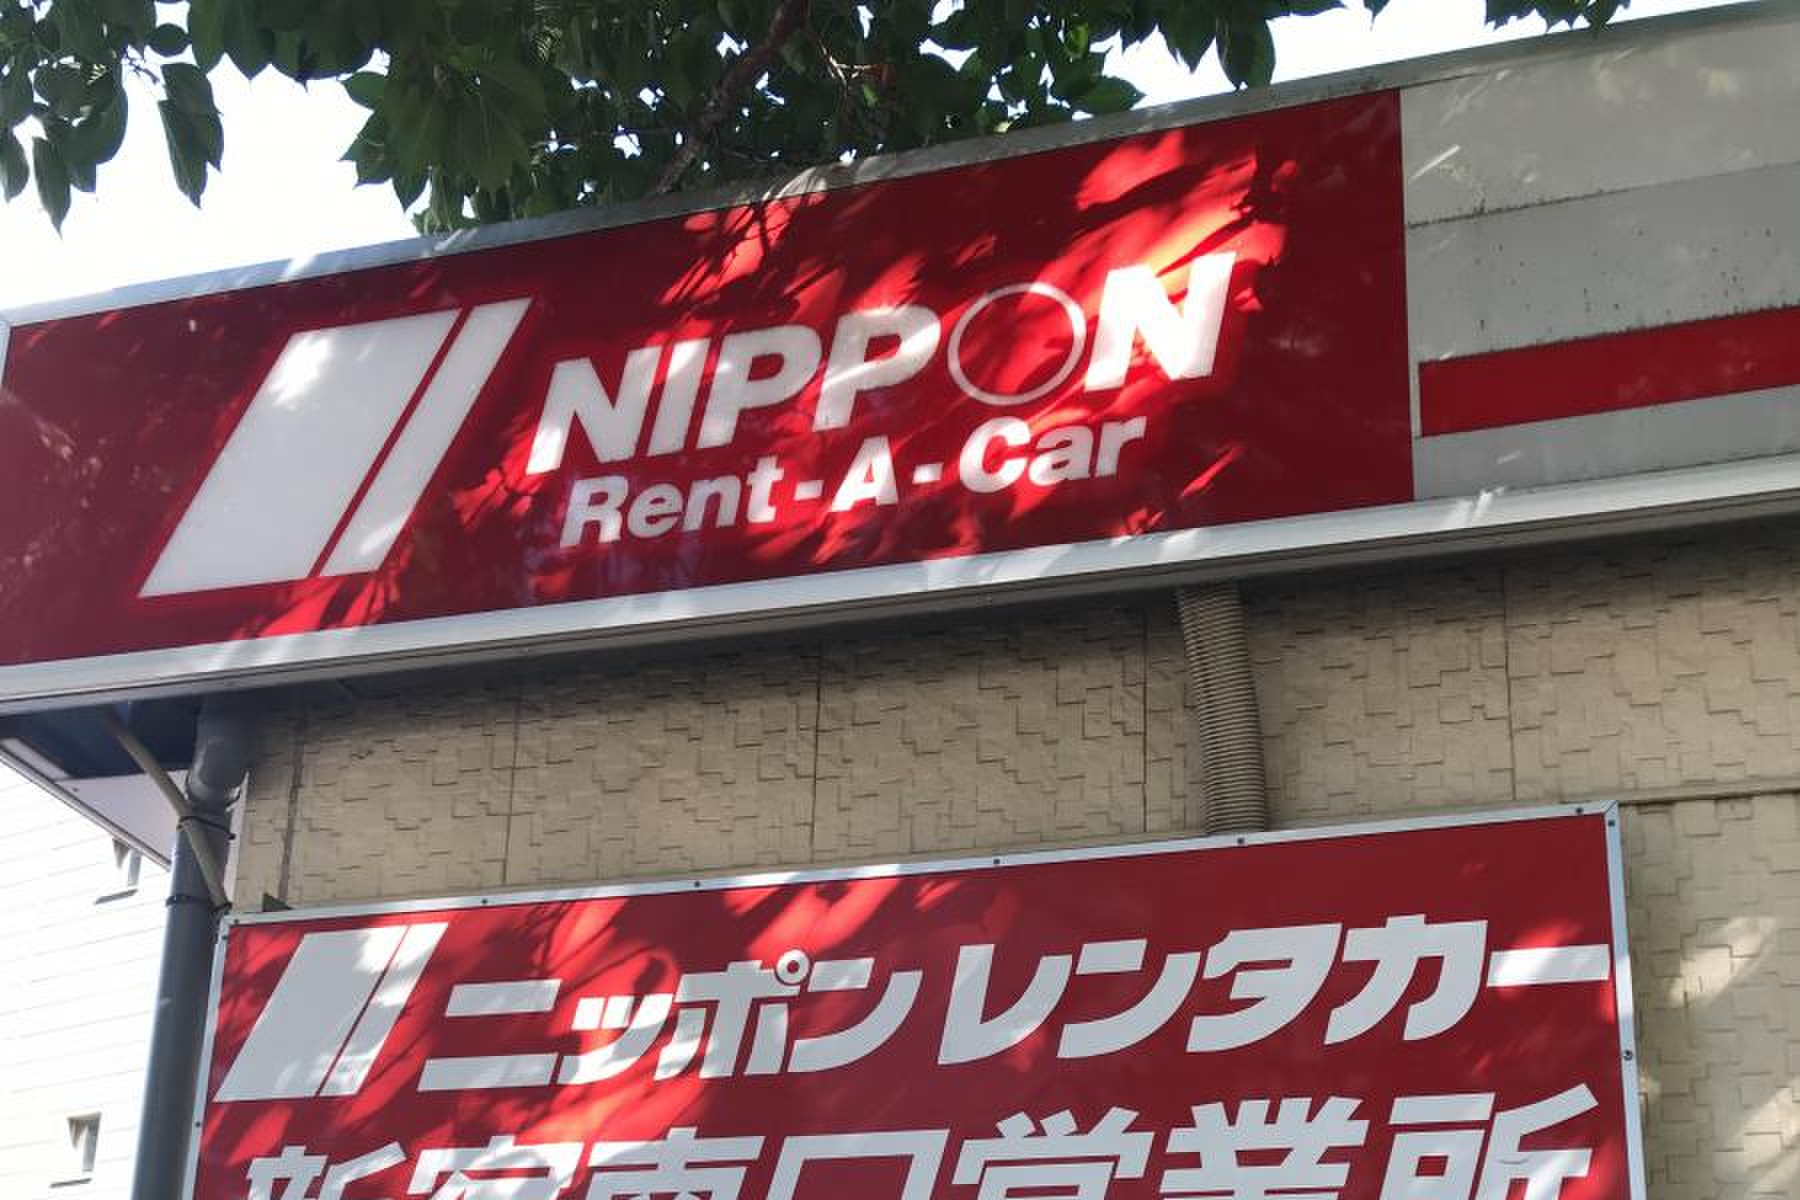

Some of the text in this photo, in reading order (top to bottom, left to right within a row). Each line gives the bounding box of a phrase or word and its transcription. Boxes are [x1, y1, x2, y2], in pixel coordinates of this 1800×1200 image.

[527, 251, 1235, 474] NIPPON
[560, 415, 1147, 547] Rent-A-Car
[417, 914, 1610, 1092] ニッポンレンタカー
